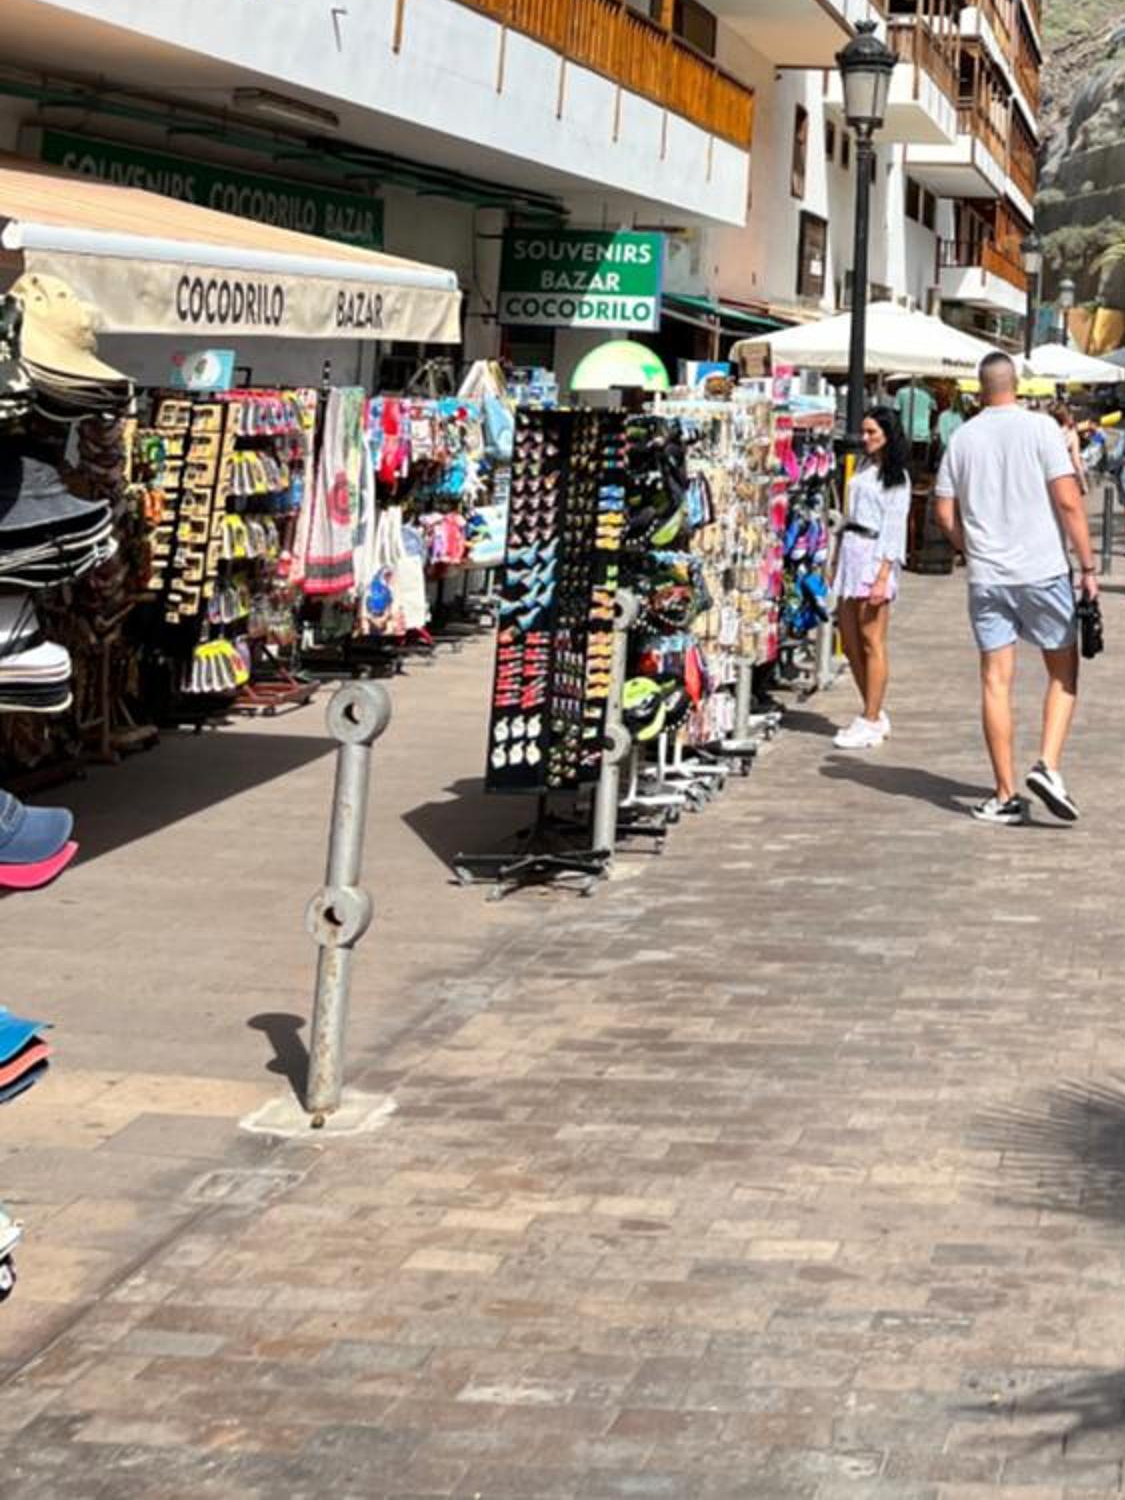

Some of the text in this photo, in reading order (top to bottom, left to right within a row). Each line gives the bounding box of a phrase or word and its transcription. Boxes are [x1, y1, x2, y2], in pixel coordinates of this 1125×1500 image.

[63, 151, 374, 241] SOUVENIRS COCODRILO BAZAR
[513, 239, 652, 264] SOUVENIRS
[540, 269, 621, 292] BAZAR
[175, 274, 384, 329] COCODRILO BAZAR
[505, 297, 652, 322] COCODRILO
